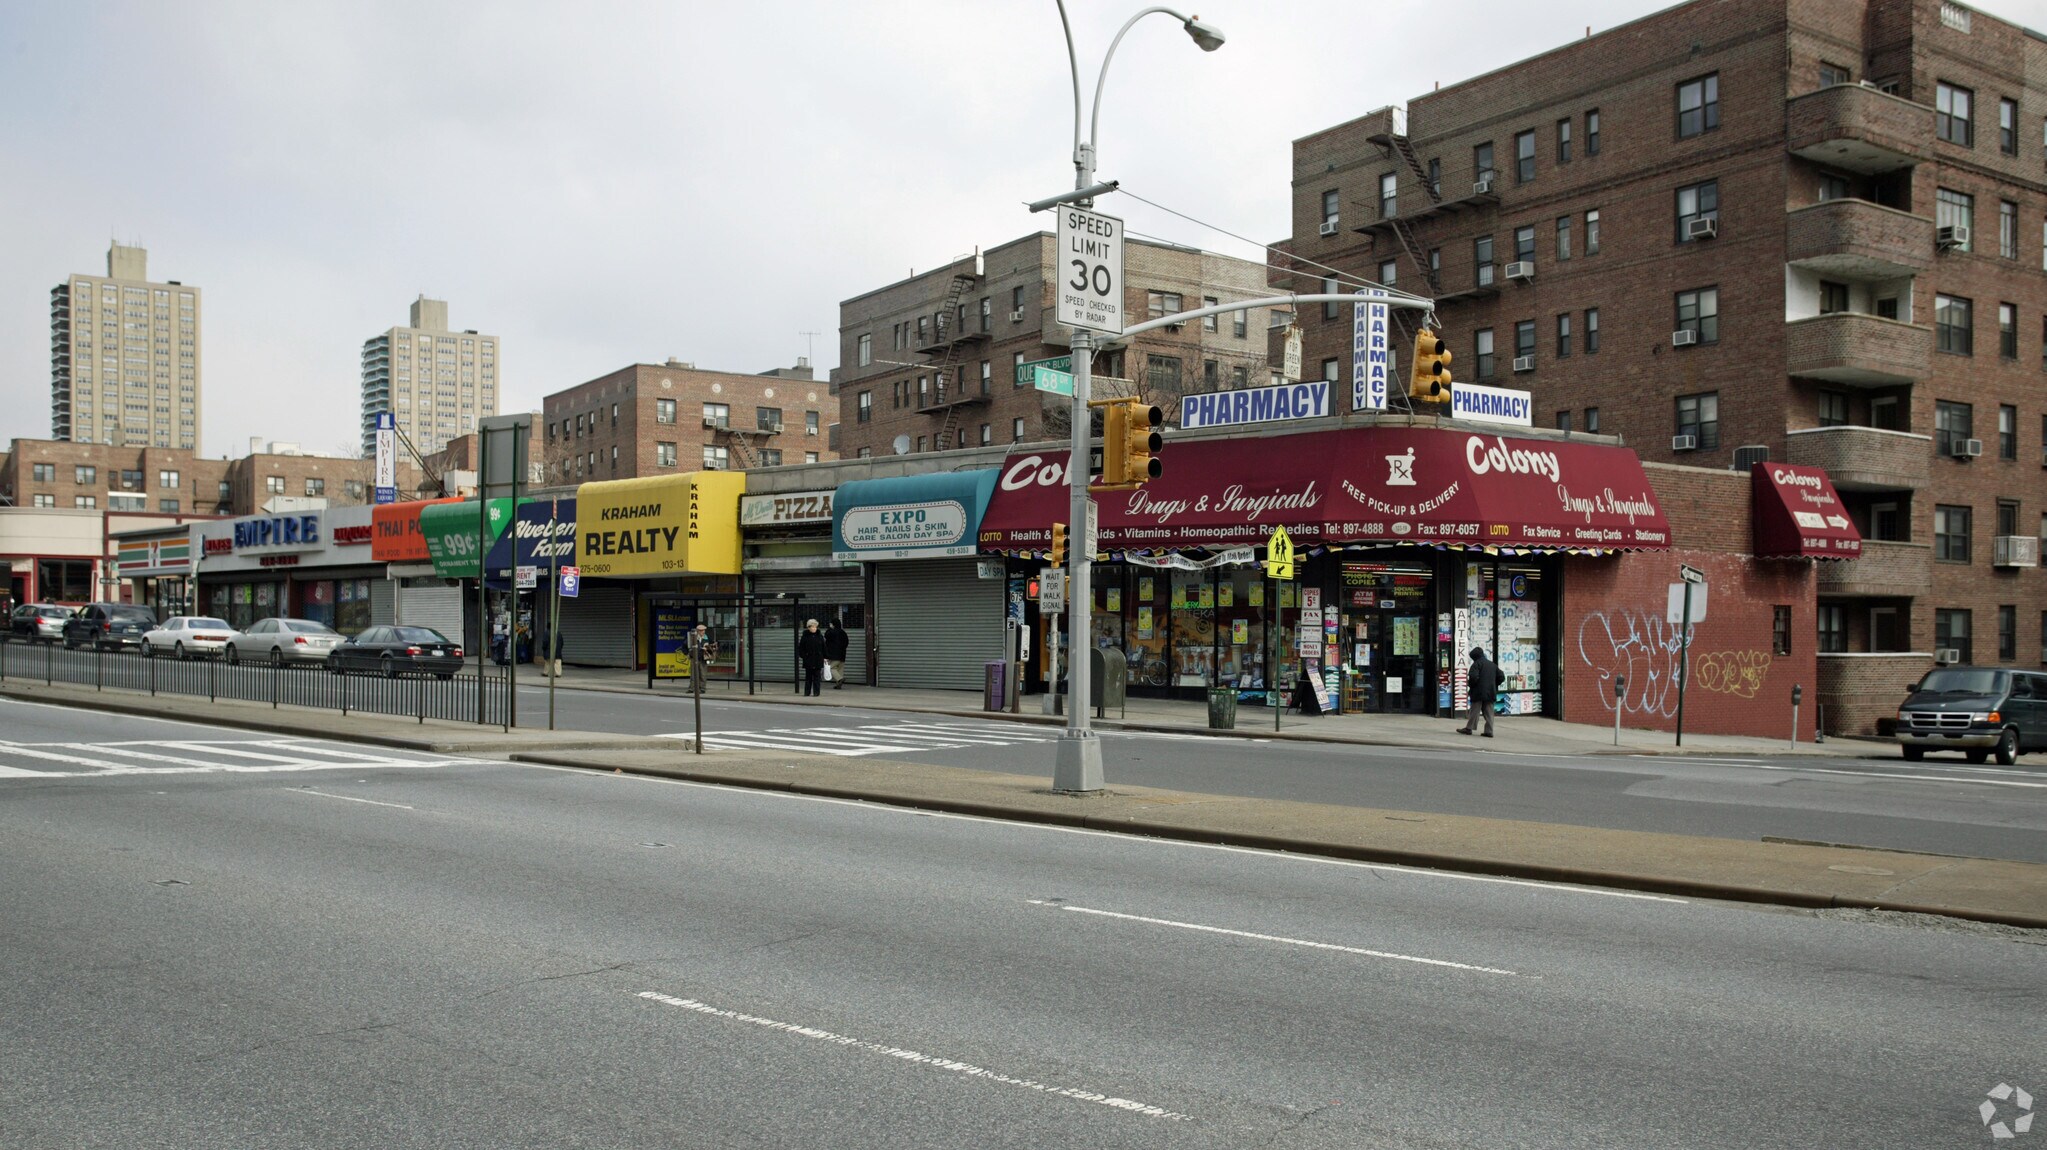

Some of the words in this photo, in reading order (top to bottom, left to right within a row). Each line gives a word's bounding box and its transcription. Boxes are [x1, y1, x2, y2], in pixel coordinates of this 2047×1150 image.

[1068, 213, 1113, 238] SPEED
[1072, 236, 1110, 259] LIMIT
[1069, 259, 1111, 296] 30
[1064, 295, 1085, 307] SPEED
[1089, 300, 1116, 314] CHECKED
[1074, 310, 1083, 319] BY
[1086, 312, 1107, 323] RADAR
[1017, 362, 1051, 382] QUE
[1052, 358, 1070, 369] BLVD
[1041, 371, 1058, 390] 68
[1060, 375, 1069, 385] DR
[1183, 383, 1327, 428] PHARMACY
[1453, 390, 1529, 419] PHARMACY
[380, 431, 390, 485] EMPIRE
[1466, 436, 1560, 483] Colony
[1774, 469, 1822, 490] Colony
[773, 495, 833, 520] PIZZA
[1125, 489, 1192, 524] Drugs
[1194, 495, 1209, 512] &
[1214, 480, 1323, 521] Surgicals
[1342, 480, 1365, 504] FREE
[1368, 497, 1407, 516] PICK-UP
[1410, 505, 1417, 516] &
[1419, 480, 1460, 514] DELIVERY
[1558, 484, 1595, 523] Drugs
[1595, 495, 1606, 513] &
[1604, 488, 1655, 525] Surgicals
[490, 507, 501, 520] 99¢
[601, 503, 661, 521] KRAHAM
[689, 483, 699, 539] KRAHAM
[880, 509, 926, 525] EXPO
[234, 515, 319, 548] EMPIRE
[377, 519, 403, 537] THAI
[879, 532, 911, 541] SALON
[913, 531, 933, 539] DAY
[936, 529, 954, 537] SPA
[885, 525, 911, 533] NAILS
[914, 524, 921, 532] &
[924, 522, 947, 531] SKIN
[980, 532, 1002, 542] LOTTO
[1010, 530, 1041, 541] Health
[1044, 530, 1052, 540] &
[1124, 526, 1171, 539] Vitamins
[1180, 524, 1256, 539] Homeopathic
[1324, 522, 1341, 534] Tel:
[1343, 522, 1384, 535] 897-4888
[1417, 523, 1438, 535] Fax:
[1439, 523, 1480, 535] 897-6057
[1489, 524, 1509, 536] LOTTO
[1523, 525, 1536, 537] Fax
[1536, 526, 1561, 538] Service
[1575, 527, 1602, 541] Greeting
[1603, 529, 1622, 540] Cards
[1635, 530, 1665, 543] Stationery
[444, 532, 475, 555] 99¢
[585, 526, 679, 556] REALTY
[662, 559, 684, 569] 103-13
[980, 567, 991, 577] DAY
[992, 567, 1005, 577] SPA
[1045, 573, 1060, 581] WAIT
[1458, 610, 1466, 666] АПТЕКА
